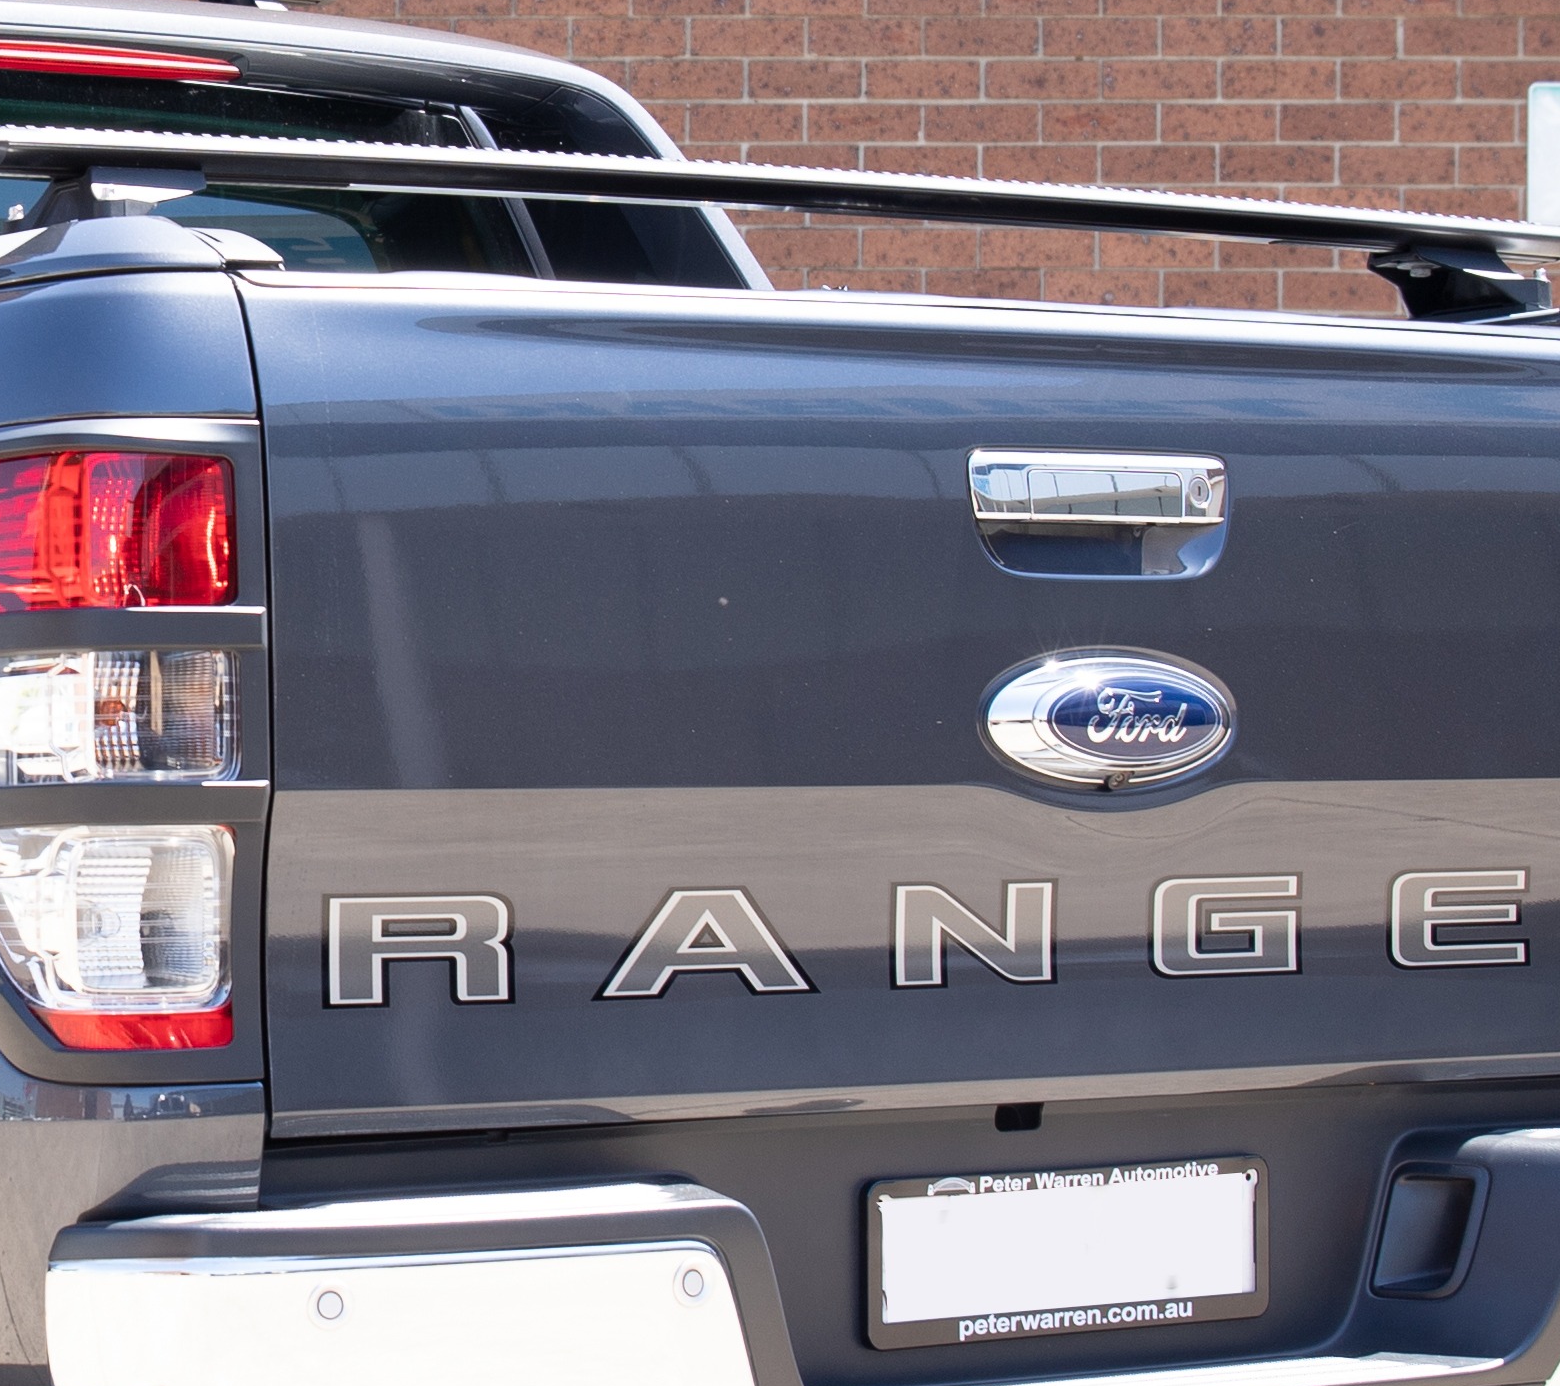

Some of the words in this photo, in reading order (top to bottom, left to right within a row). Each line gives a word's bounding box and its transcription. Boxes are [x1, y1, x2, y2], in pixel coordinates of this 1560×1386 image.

[1087, 687, 1187, 743] Ford
[979, 1176, 1031, 1193] Peter
[1034, 1170, 1104, 1189] Warren
[1108, 1161, 1219, 1186] Automotive
[958, 1300, 1194, 1342] peterwarren.com.au
